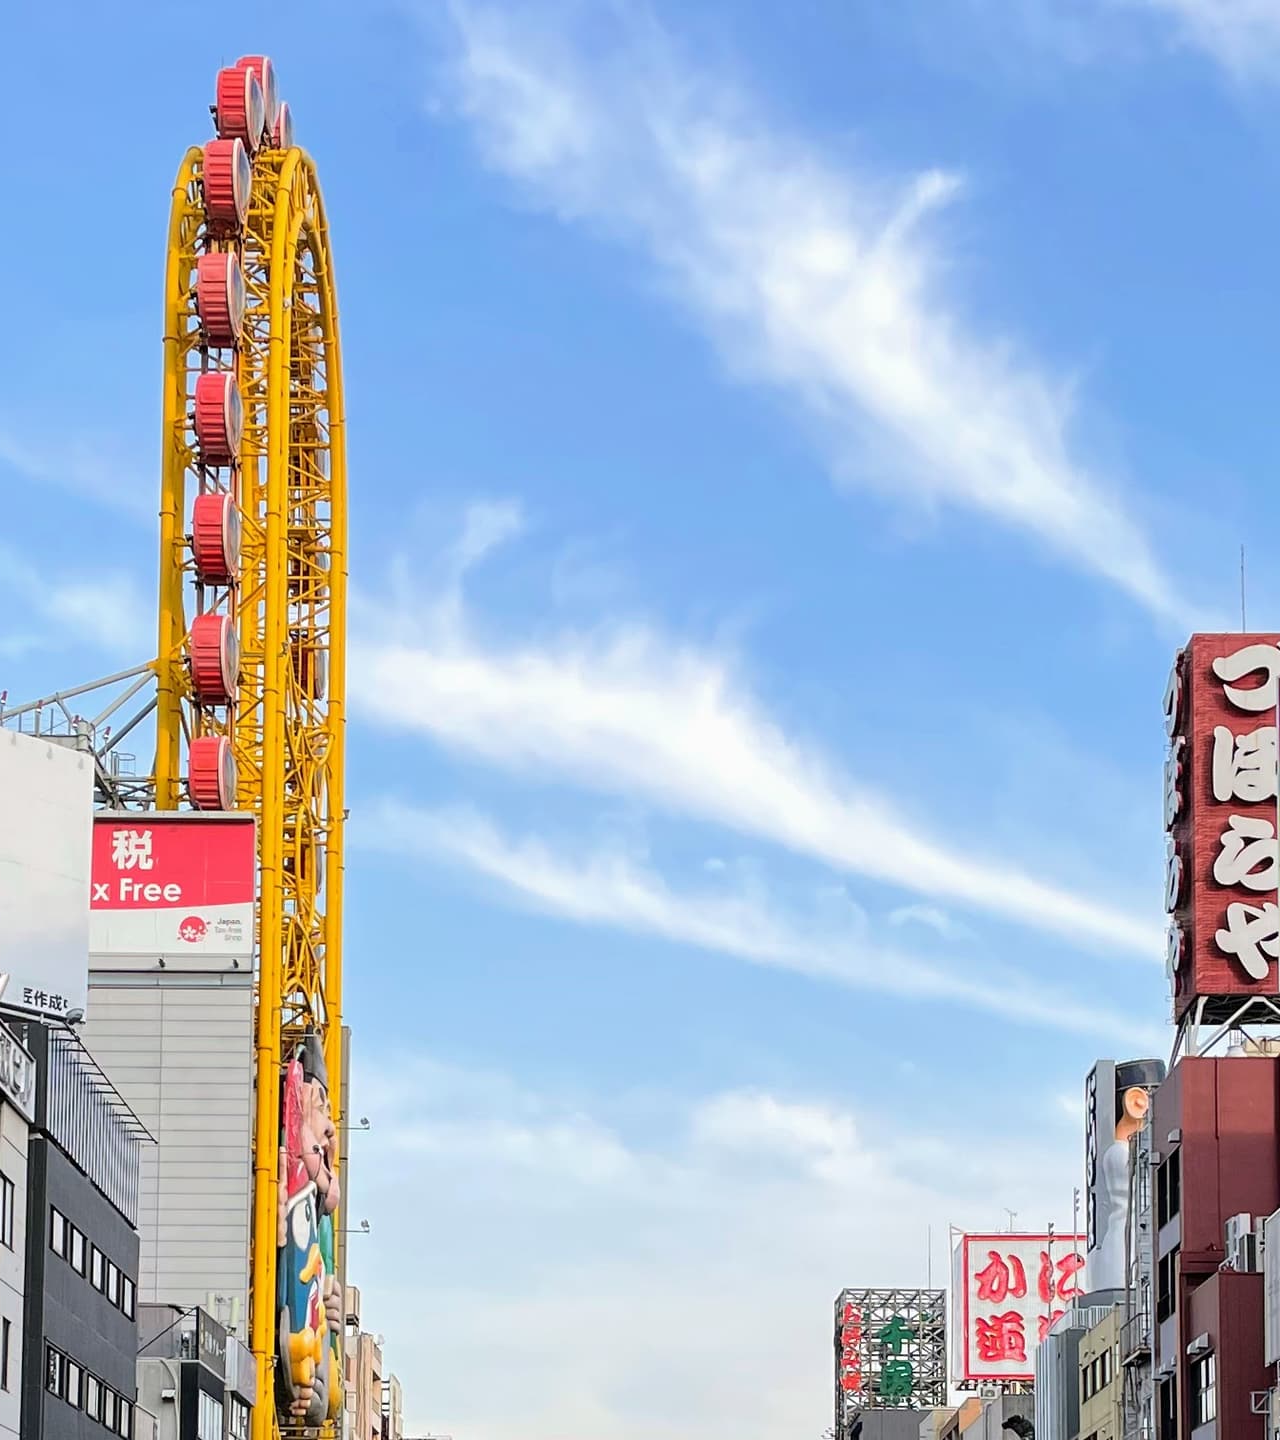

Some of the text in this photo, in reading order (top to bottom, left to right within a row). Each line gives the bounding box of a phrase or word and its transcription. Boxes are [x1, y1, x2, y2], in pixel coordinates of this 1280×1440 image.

[111, 829, 154, 871] 税
[119, 878, 182, 902] Free
[974, 1250, 1086, 1303] かに
